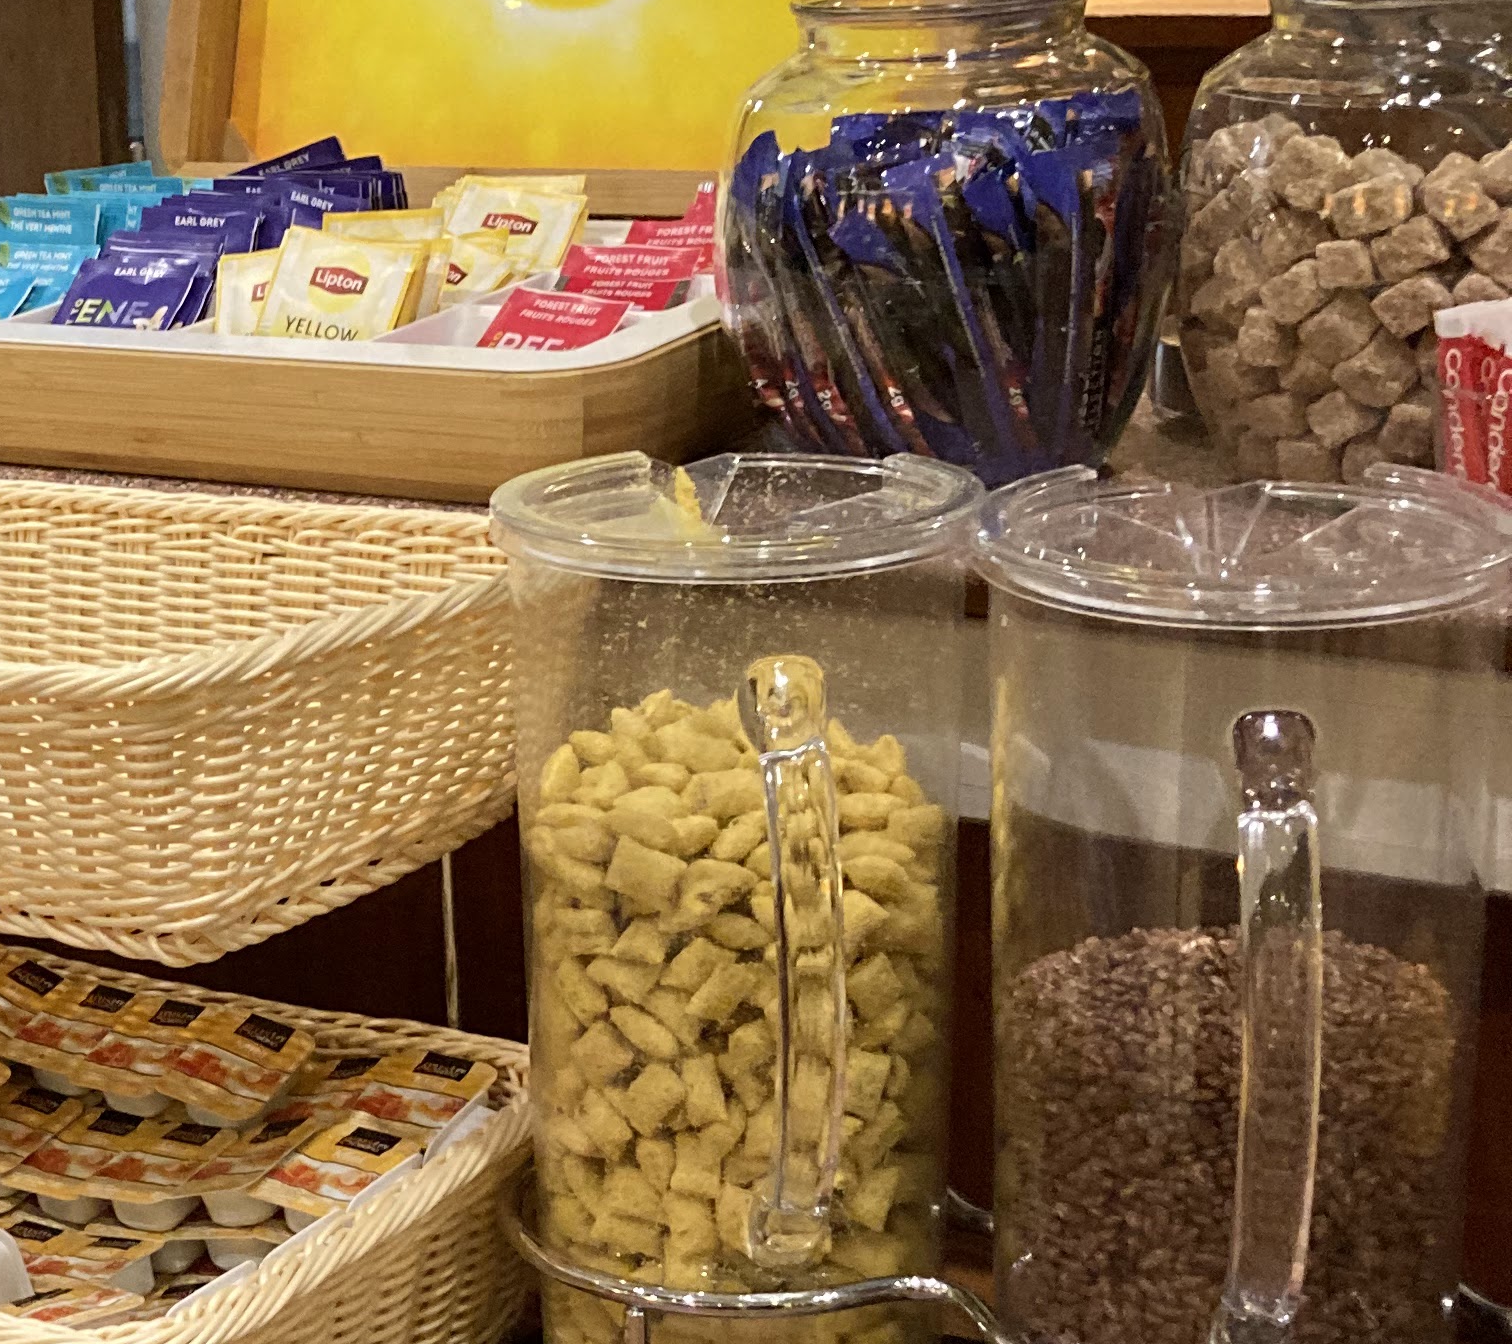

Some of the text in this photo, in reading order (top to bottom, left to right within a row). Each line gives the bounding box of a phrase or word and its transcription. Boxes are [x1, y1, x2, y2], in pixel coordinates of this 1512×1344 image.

[291, 190, 334, 211] EARL GREY
[175, 215, 226, 228] EARL GREY
[487, 214, 533, 233] Lipton
[656, 225, 698, 236] FOREST
[594, 254, 670, 266] FOREST FRUIT
[113, 266, 137, 276] EARL
[314, 269, 364, 293] Lipton
[533, 298, 603, 316] FOREST FRUIT
[285, 314, 359, 341] YELLOW
